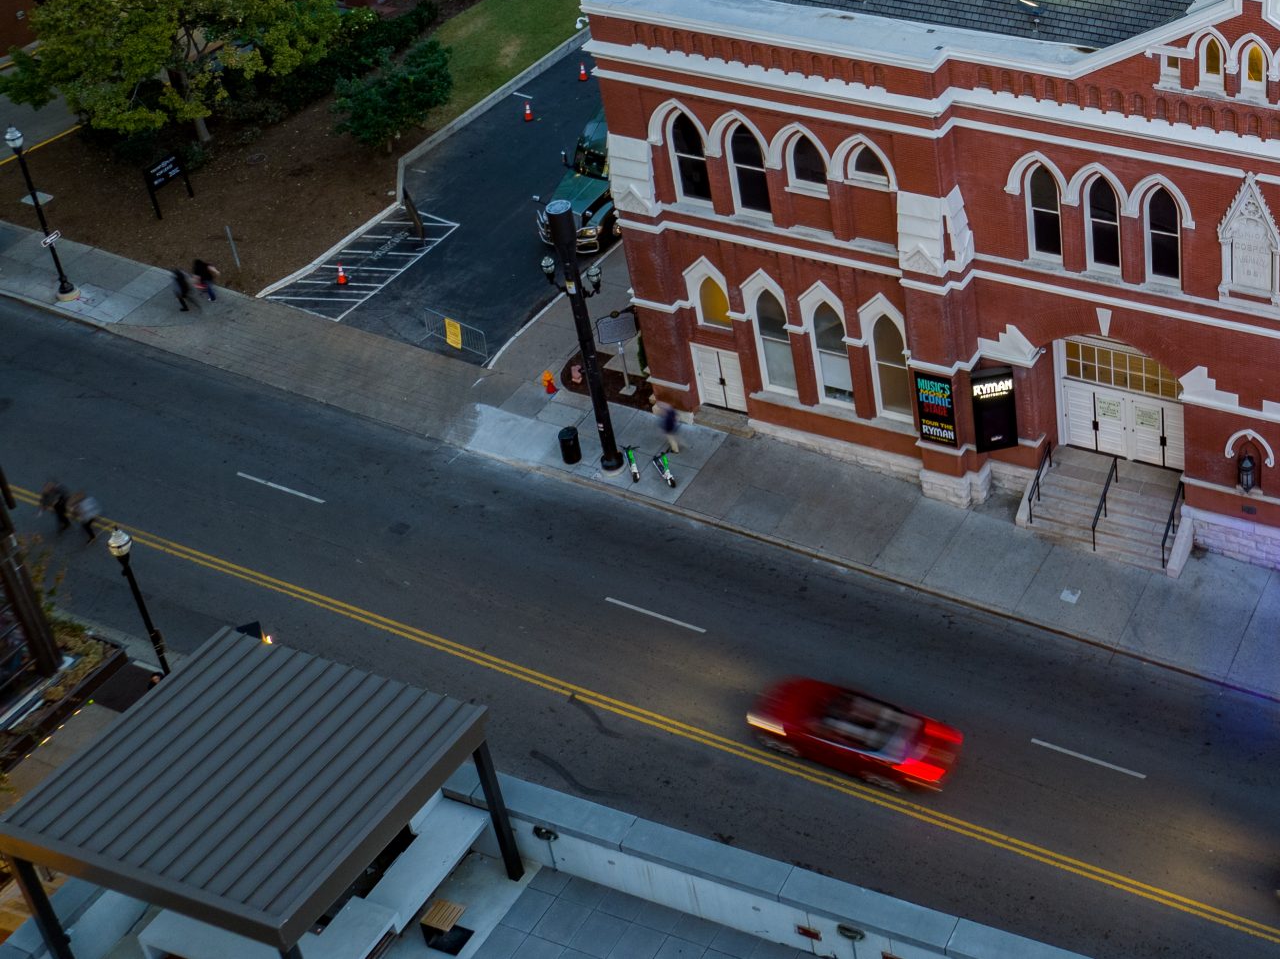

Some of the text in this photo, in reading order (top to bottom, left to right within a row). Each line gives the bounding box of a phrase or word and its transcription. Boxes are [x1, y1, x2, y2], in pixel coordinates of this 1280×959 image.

[917, 378, 950, 395] MUSIC'S
[972, 378, 1013, 397] RYMAN
[919, 393, 952, 408] ICONIC
[923, 403, 948, 416] STAGE
[921, 419, 953, 430] TOUR THE
[922, 425, 955, 440] RYMAN
